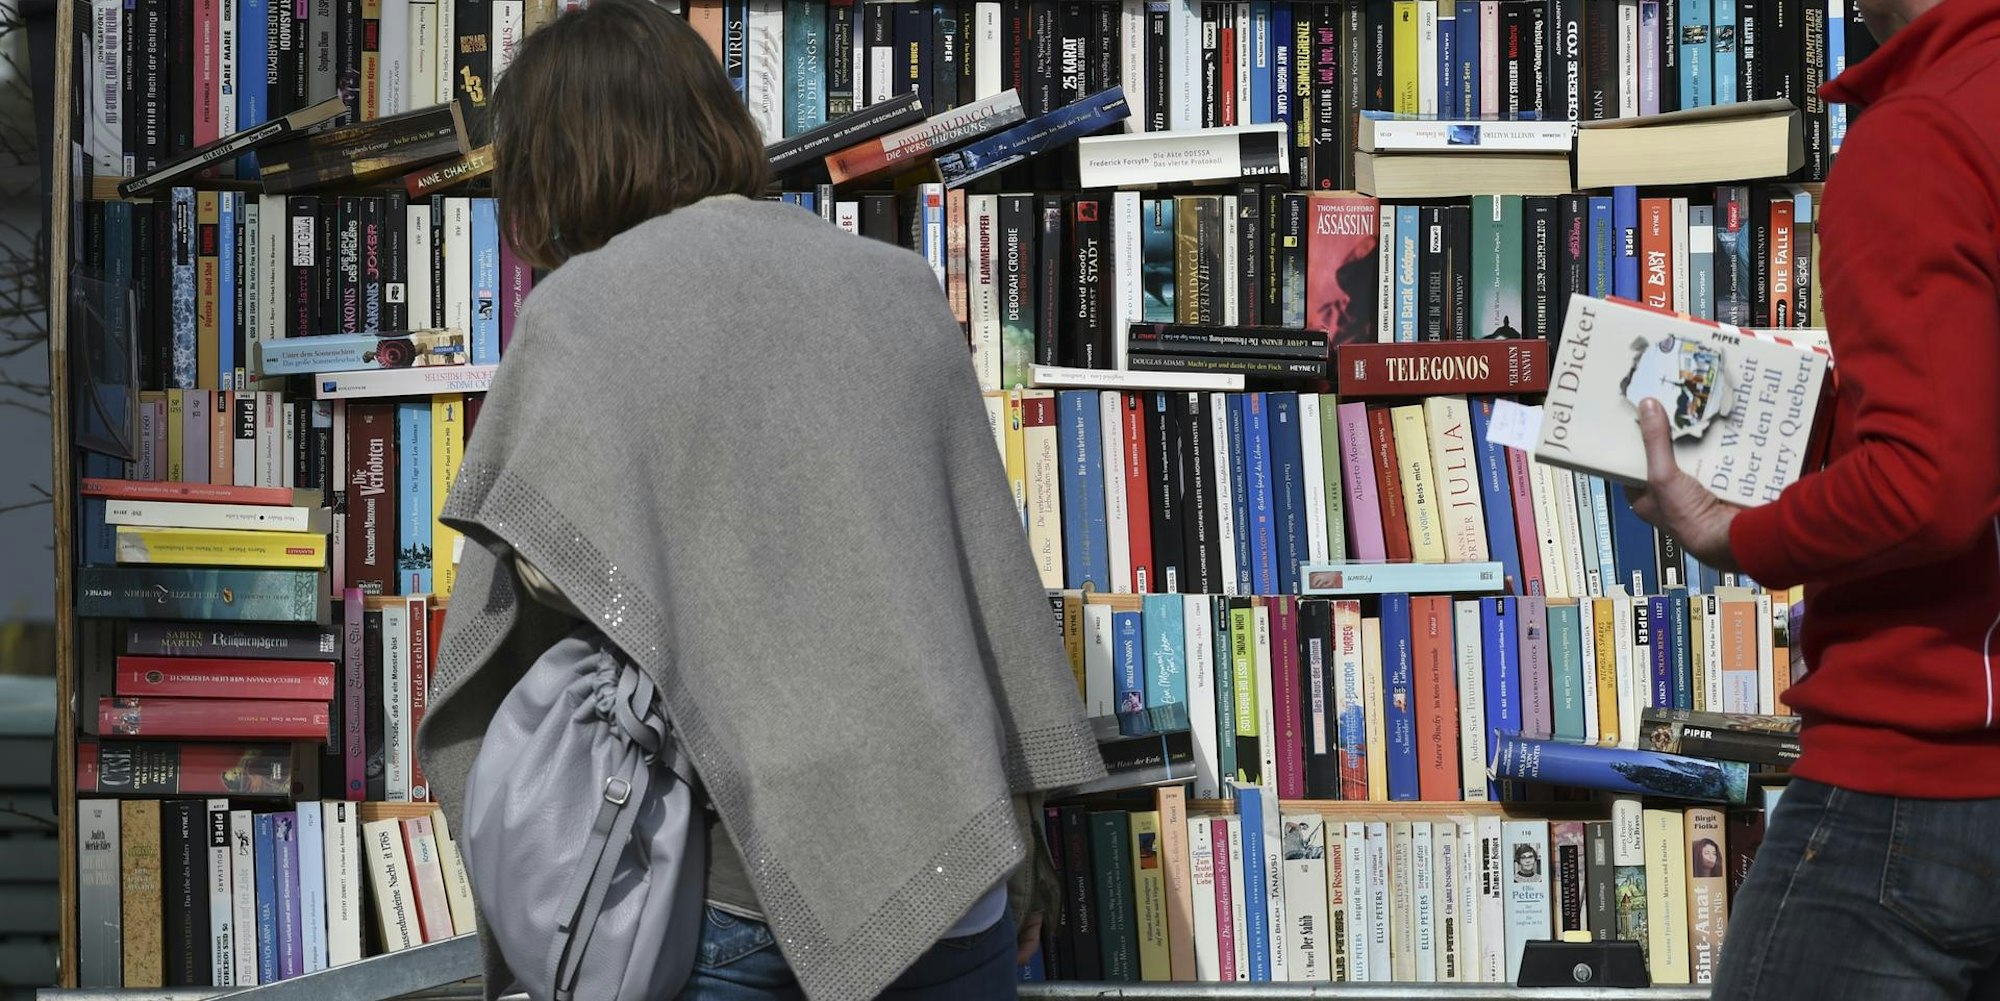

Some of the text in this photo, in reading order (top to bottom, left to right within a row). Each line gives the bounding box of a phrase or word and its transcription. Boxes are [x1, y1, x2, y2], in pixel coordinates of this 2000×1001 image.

[267, 16, 278, 84] DER HARPYIEN
[729, 20, 742, 68] VIRUS
[910, 42, 918, 64] BUICK
[1297, 21, 1310, 96] SCHMERZGRENZE
[1567, 21, 1578, 58] TOD
[1806, 9, 1816, 113] DIE EURO-ERMITTLER
[222, 64, 232, 94] MARIE
[807, 30, 816, 119] IN DIE ANGST
[1063, 37, 1077, 89] 25 KARAT
[1278, 46, 1287, 114] MARY HIGGINS CLARK
[1509, 60, 1518, 93] STRIEBER
[898, 104, 997, 148] DAVID BALDACCI
[202, 144, 234, 160] GLAUSER
[418, 156, 485, 190] ANNE CHAPLET
[1090, 158, 1149, 167] Frederick Forsyth
[1167, 150, 1182, 158] Akte
[1184, 149, 1210, 158] ODESSA
[1242, 166, 1278, 176] PIPER
[1290, 200, 1298, 235] ullstein
[1316, 212, 1374, 236] ASSASSINI
[294, 218, 310, 265] ENIGMA
[349, 220, 357, 282] DES SPIELERS
[980, 215, 990, 284] FLAMMENOPFER
[1087, 238, 1098, 283] STADT
[1625, 229, 1633, 256] PIPER
[1775, 227, 1788, 293] DIE FALLE
[366, 224, 379, 330] KAKONIS JOKER
[1007, 228, 1019, 320] DEBORAH CROMBIE
[1078, 249, 1088, 318] David Moody
[1189, 250, 1199, 308] BALDACCI
[1536, 219, 1546, 333] FREEMANTLE DER LEHRLING
[1647, 251, 1665, 285] BABY
[344, 288, 355, 334] KAKONIS
[1400, 288, 1413, 318] Barak
[1796, 256, 1808, 327] Auf zum Gipfel
[1711, 332, 1740, 347] PIPER
[1132, 358, 1185, 368] DOUGLAS ADAMS
[1290, 364, 1310, 372] HEYNE
[1386, 354, 1490, 382] TELEGONOS
[1508, 346, 1518, 386] KNEIFEL
[1522, 350, 1530, 382] HANNS
[1543, 306, 1596, 452] Joël Dicker
[243, 402, 253, 437] PIPER
[1711, 356, 1758, 492] Die Wahrheit
[1741, 368, 1783, 498] über den Fall
[1762, 355, 1815, 504] Harry Quebert
[359, 438, 385, 496] Verlobten
[1193, 446, 1199, 456] AM
[1347, 422, 1363, 500] Alberto Moravia
[1443, 423, 1478, 509] JULIA
[352, 469, 366, 485] Die
[1412, 462, 1431, 546] Eva Völler Beiss mich
[364, 498, 375, 566] Alessandro Manzoni
[1042, 538, 1051, 572] Eva Rice
[160, 638, 203, 647] MARTIN
[166, 631, 203, 639] SABINE
[1235, 614, 1246, 656] JOHN IRVING
[1637, 610, 1648, 644] PIPER
[414, 629, 423, 708] Pferde stehlen
[1310, 641, 1322, 713] Das Haus der Spinne
[391, 694, 398, 703] du
[1464, 645, 1479, 763] Andrea Sixt Traumtochter
[391, 720, 400, 747] Schade,
[1684, 728, 1713, 740] PIPER
[213, 813, 224, 844] PIPER
[379, 831, 398, 888] Nacht 1768
[1217, 839, 1226, 872] Schatulle
[1331, 844, 1342, 905] Der Rosenmord
[1220, 874, 1230, 922] wundersame
[1512, 890, 1545, 900] Peters
[1713, 892, 1724, 936] des Nils
[1222, 923, 1230, 938] Die
[1298, 915, 1314, 950] Der Sahib
[1375, 891, 1384, 944] ELLIS PETERS
[1420, 895, 1429, 950] ELLIS PETERS
[1694, 885, 1712, 984] Bint-Anat
